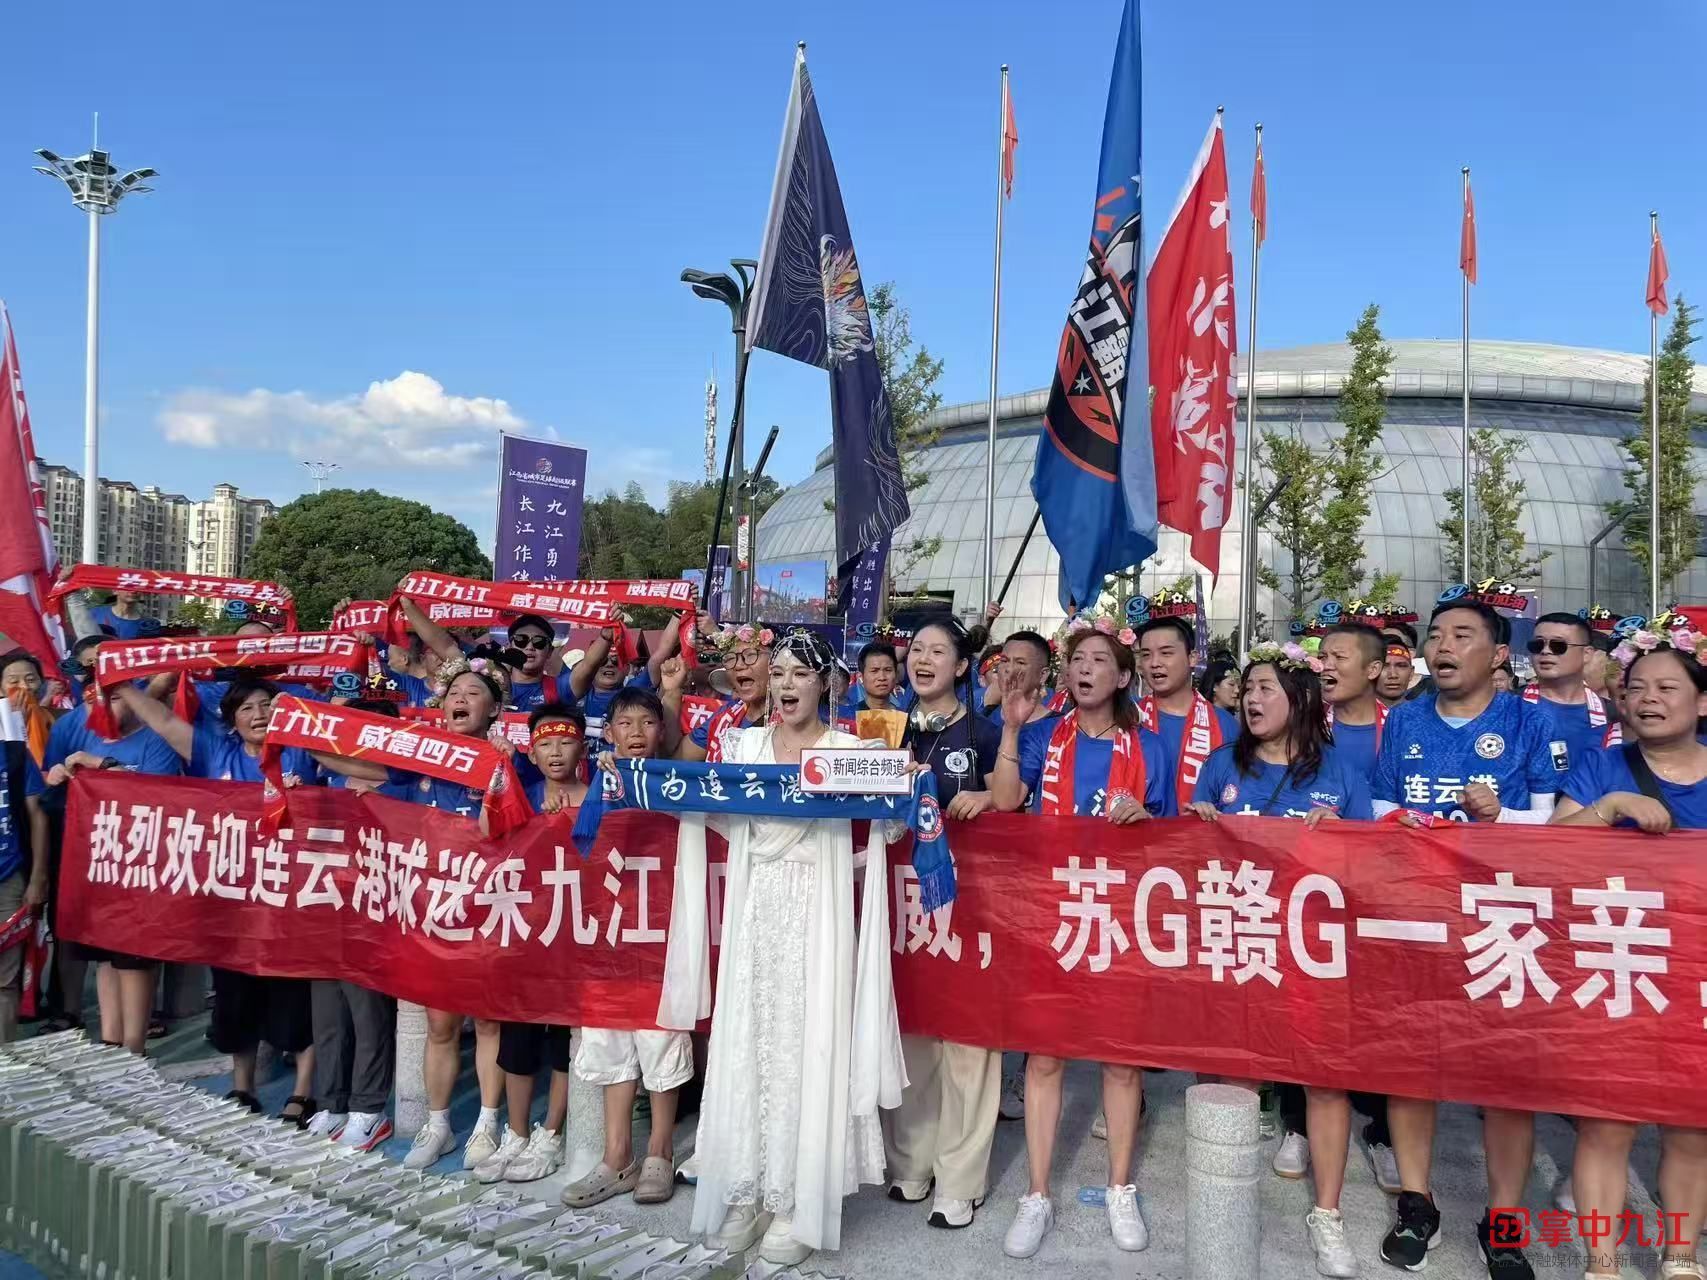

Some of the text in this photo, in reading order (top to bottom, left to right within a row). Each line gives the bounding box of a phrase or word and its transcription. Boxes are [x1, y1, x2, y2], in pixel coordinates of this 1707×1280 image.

[627, 580, 691, 601] 威震四
[99, 634, 357, 675] 九江九江 威震四方
[356, 724, 479, 773] 威震四方
[833, 758, 904, 776] 新闻综合频道
